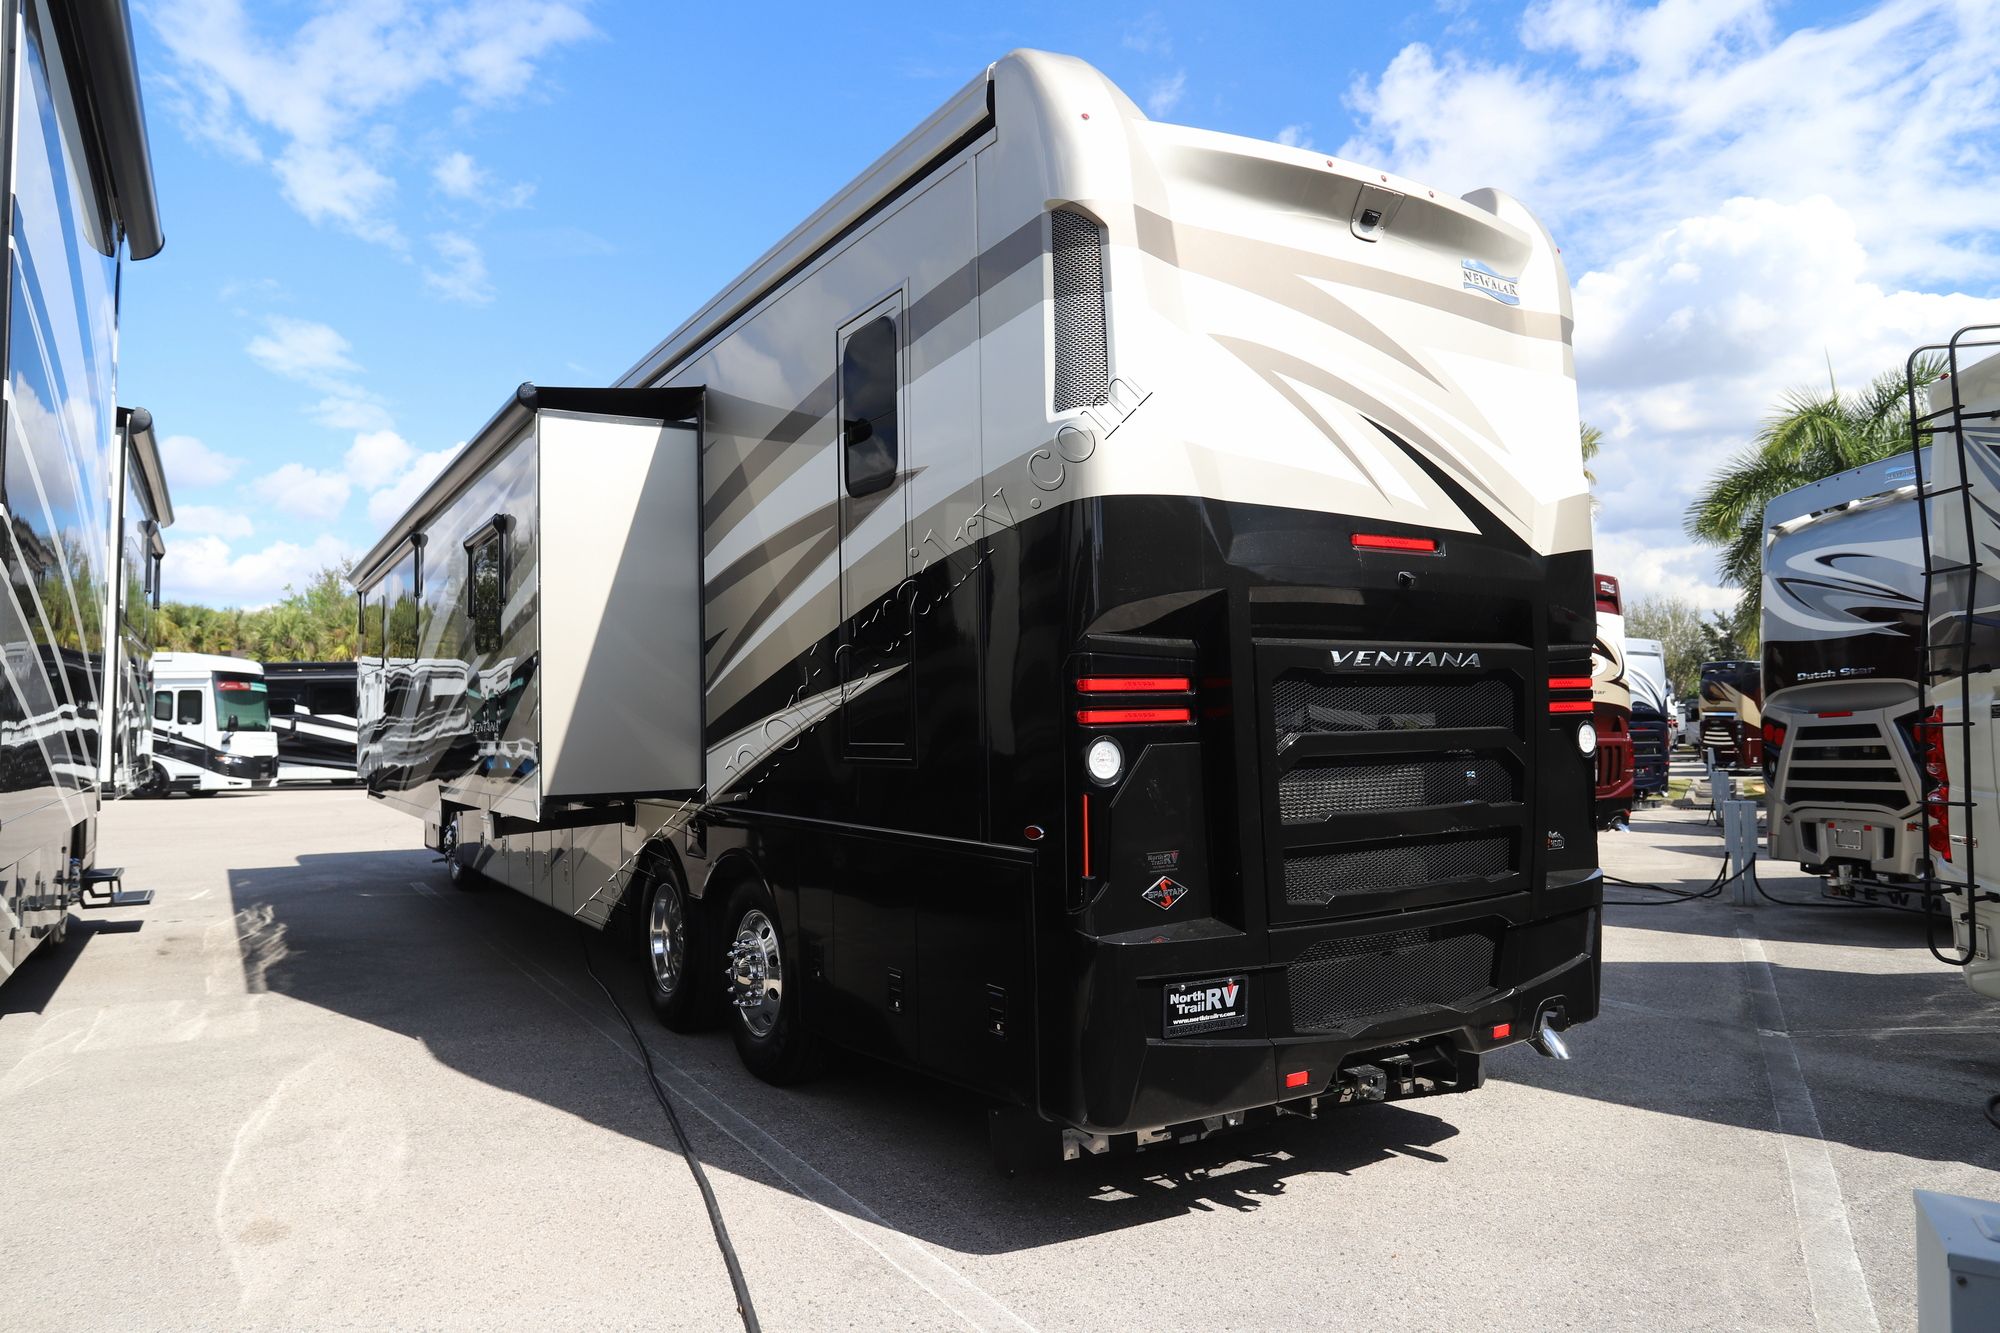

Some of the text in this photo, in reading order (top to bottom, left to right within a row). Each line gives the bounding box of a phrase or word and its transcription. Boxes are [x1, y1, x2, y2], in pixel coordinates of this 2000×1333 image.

[1463, 270, 1518, 296] NEWMAR
[1330, 650, 1481, 668] VENTANA
[1797, 666, 1876, 681] Dutch Star
[1147, 887, 1184, 899] SPARTAN
[1170, 991, 1205, 1005] North
[1176, 984, 1239, 1015] Trail RV
[1173, 1011, 1236, 1024] www.northtrailrv.com
